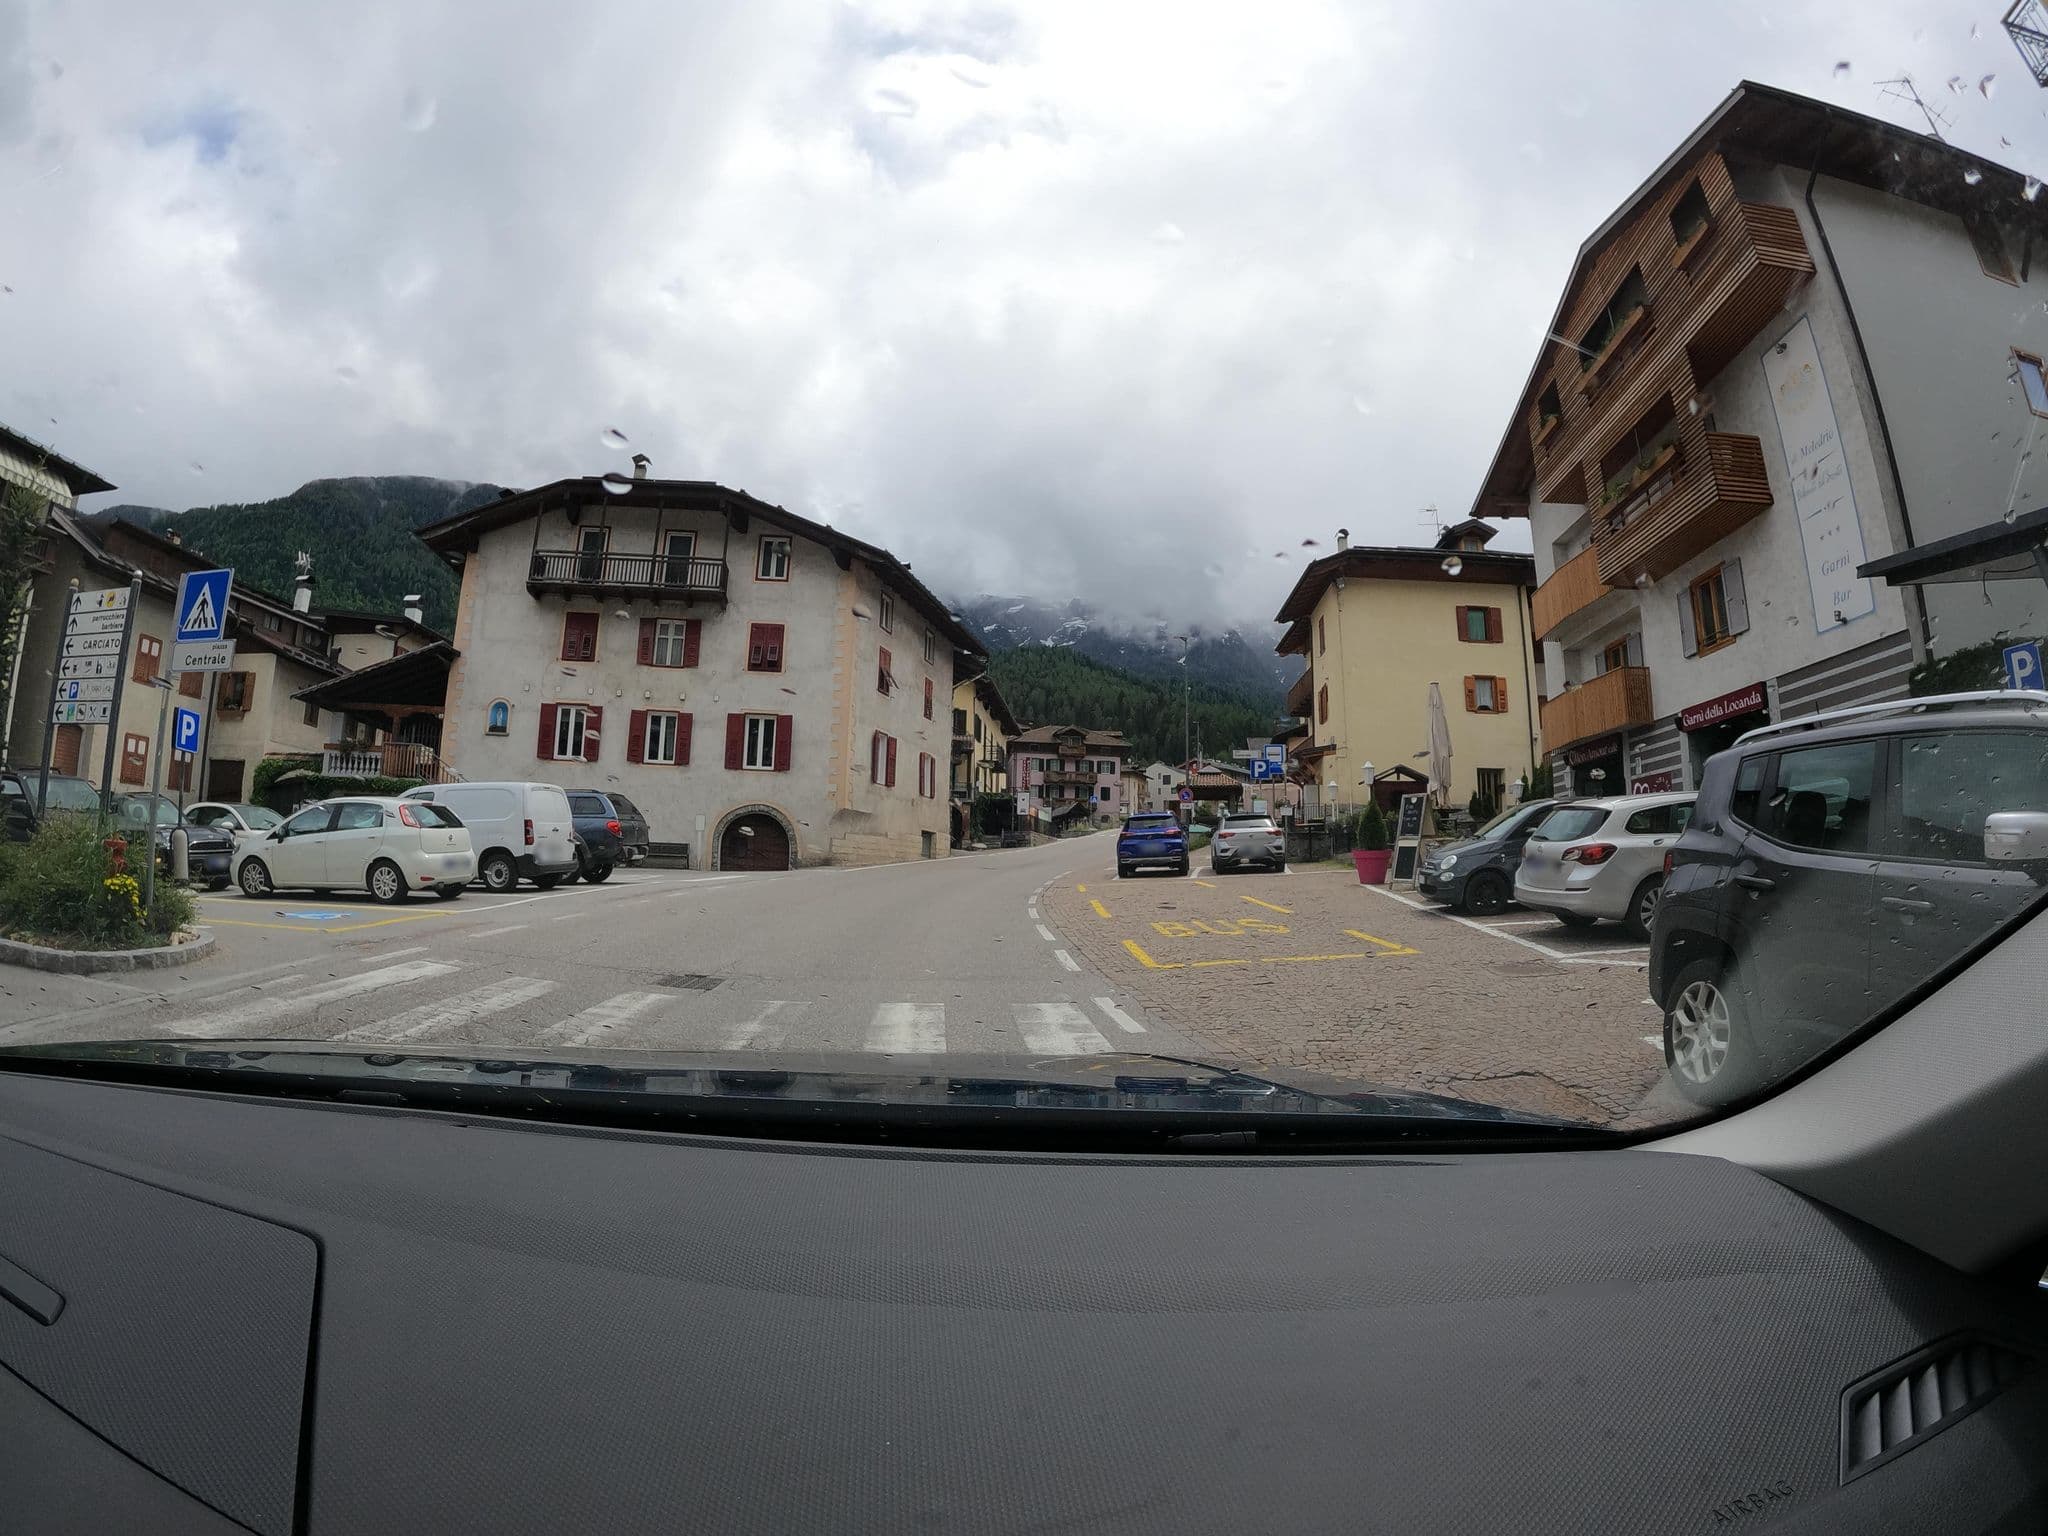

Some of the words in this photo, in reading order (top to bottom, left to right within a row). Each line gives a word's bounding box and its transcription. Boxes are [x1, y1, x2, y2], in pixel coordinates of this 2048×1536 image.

[1833, 590, 1852, 606] Bar
[82, 638, 121, 650] CARCIATO
[185, 653, 226, 666] Centrale
[2011, 650, 2034, 689] P
[1705, 702, 1723, 719] della
[1724, 691, 1762, 714] Locanda
[181, 714, 196, 745] P
[1254, 761, 1267, 778] P
[1151, 917, 1291, 938] BUS
[1712, 1479, 1796, 1524] AIRBAG
